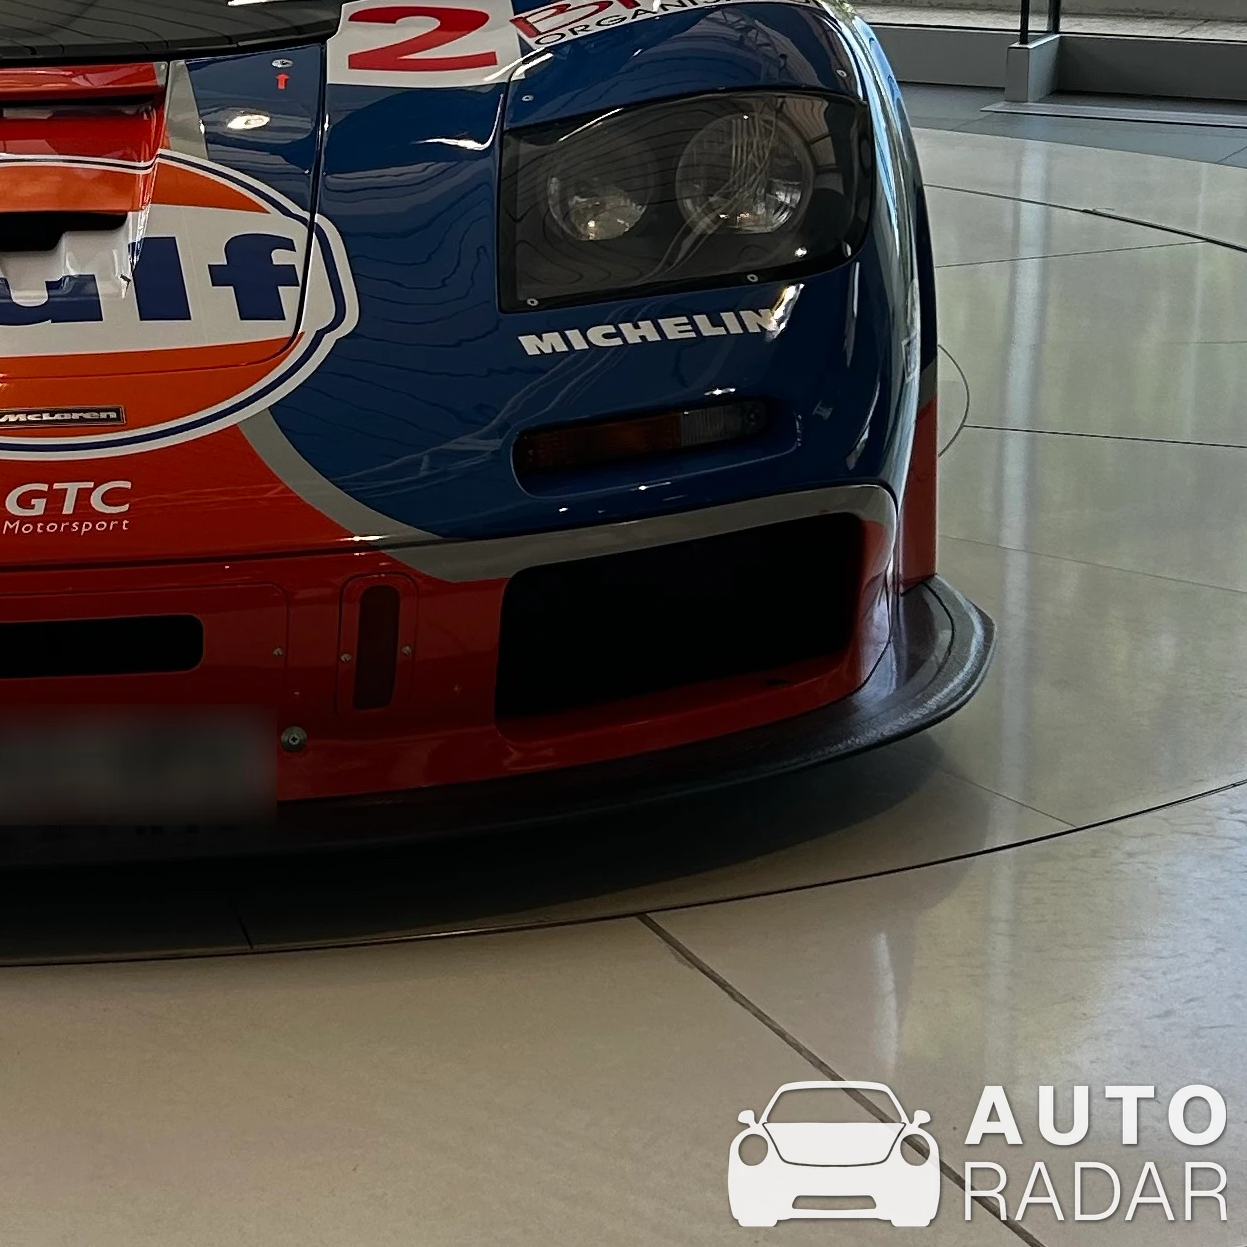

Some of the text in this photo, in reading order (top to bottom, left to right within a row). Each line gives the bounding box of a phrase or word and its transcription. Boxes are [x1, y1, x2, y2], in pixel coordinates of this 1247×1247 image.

[347, 5, 498, 71] 2
[518, 308, 779, 356] MICHELIN
[5, 480, 132, 517] GTC
[2, 519, 130, 536] Motorsport
